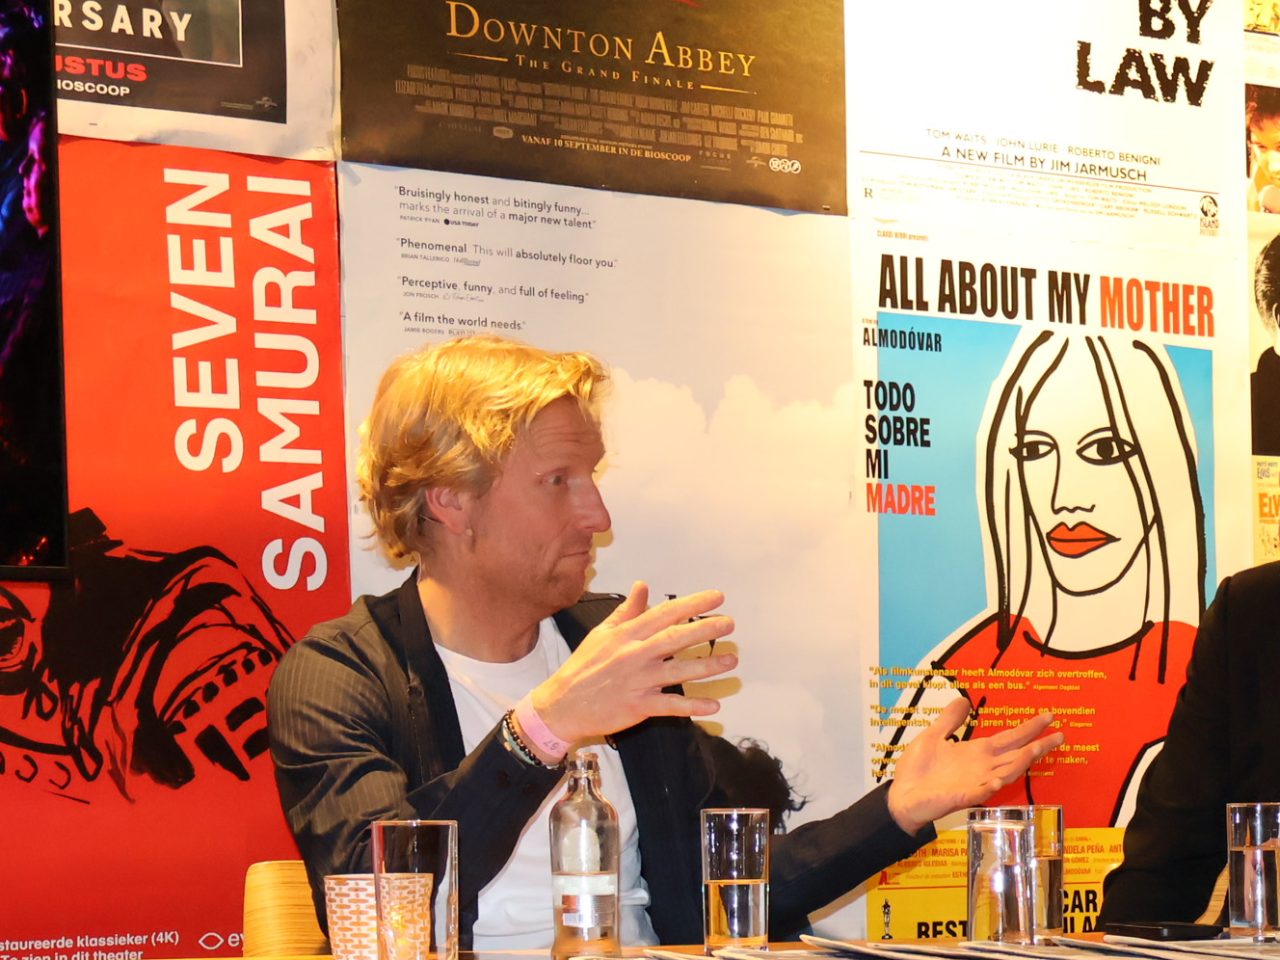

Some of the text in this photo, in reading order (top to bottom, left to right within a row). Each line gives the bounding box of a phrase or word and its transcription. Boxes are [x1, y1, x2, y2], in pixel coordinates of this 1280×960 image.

[1139, 0, 1213, 44] BY
[446, 1, 756, 77] DOWNTON ABBEY
[515, 54, 694, 90] THE GRAND FINALE
[1076, 40, 1215, 107] LAW
[521, 134, 551, 146] VANAF
[564, 140, 617, 154] SEPTEMBER
[618, 148, 629, 156] IN
[630, 149, 643, 158] DE
[644, 151, 692, 163] BIOSCOOP
[926, 128, 1161, 167] TOM WAITS JOHN LURIE ROBERTO BENIGNI
[941, 146, 1147, 182] A NEW FILM BY JIM JARMUSCH
[399, 201, 430, 213] marks
[433, 203, 450, 214] the
[453, 206, 484, 218] arrival
[487, 208, 497, 219] of
[508, 211, 538, 224] major
[540, 216, 561, 226] new
[454, 191, 490, 204] honest
[492, 197, 511, 207] and
[513, 198, 552, 214] bitingly
[473, 244, 494, 257] This
[496, 247, 513, 259] will
[515, 249, 567, 265] absolutely
[569, 254, 592, 266] floor
[498, 285, 517, 295] and
[519, 286, 535, 297] full
[538, 288, 548, 298] of
[878, 253, 1215, 338] ALL ABOUT MY MOTHER
[163, 168, 244, 473] SEVEN
[414, 311, 435, 323] film
[437, 314, 455, 325] the
[457, 316, 488, 328] world
[862, 325, 942, 353] ALMODÓVAR
[246, 175, 328, 591] SAMURAI
[863, 379, 916, 413] TODO
[865, 414, 931, 448] SOBRE
[865, 448, 889, 480] MI
[865, 482, 936, 517] MADRE
[869, 679, 879, 689] in
[881, 679, 894, 689] dit
[896, 680, 921, 691] geval
[949, 680, 970, 690] alles
[972, 680, 986, 690] als
[988, 681, 1005, 690] een
[961, 667, 985, 678] heeft
[1036, 668, 1055, 679] zich
[978, 706, 1035, 718] aangrijpende
[1052, 707, 1096, 716] bovendien
[981, 718, 1004, 729] jaren
[1060, 744, 1100, 752] de meest
[931, 847, 959, 857] MARISA
[77, 932, 148, 948] klassieker
[150, 931, 180, 946] (4K)
